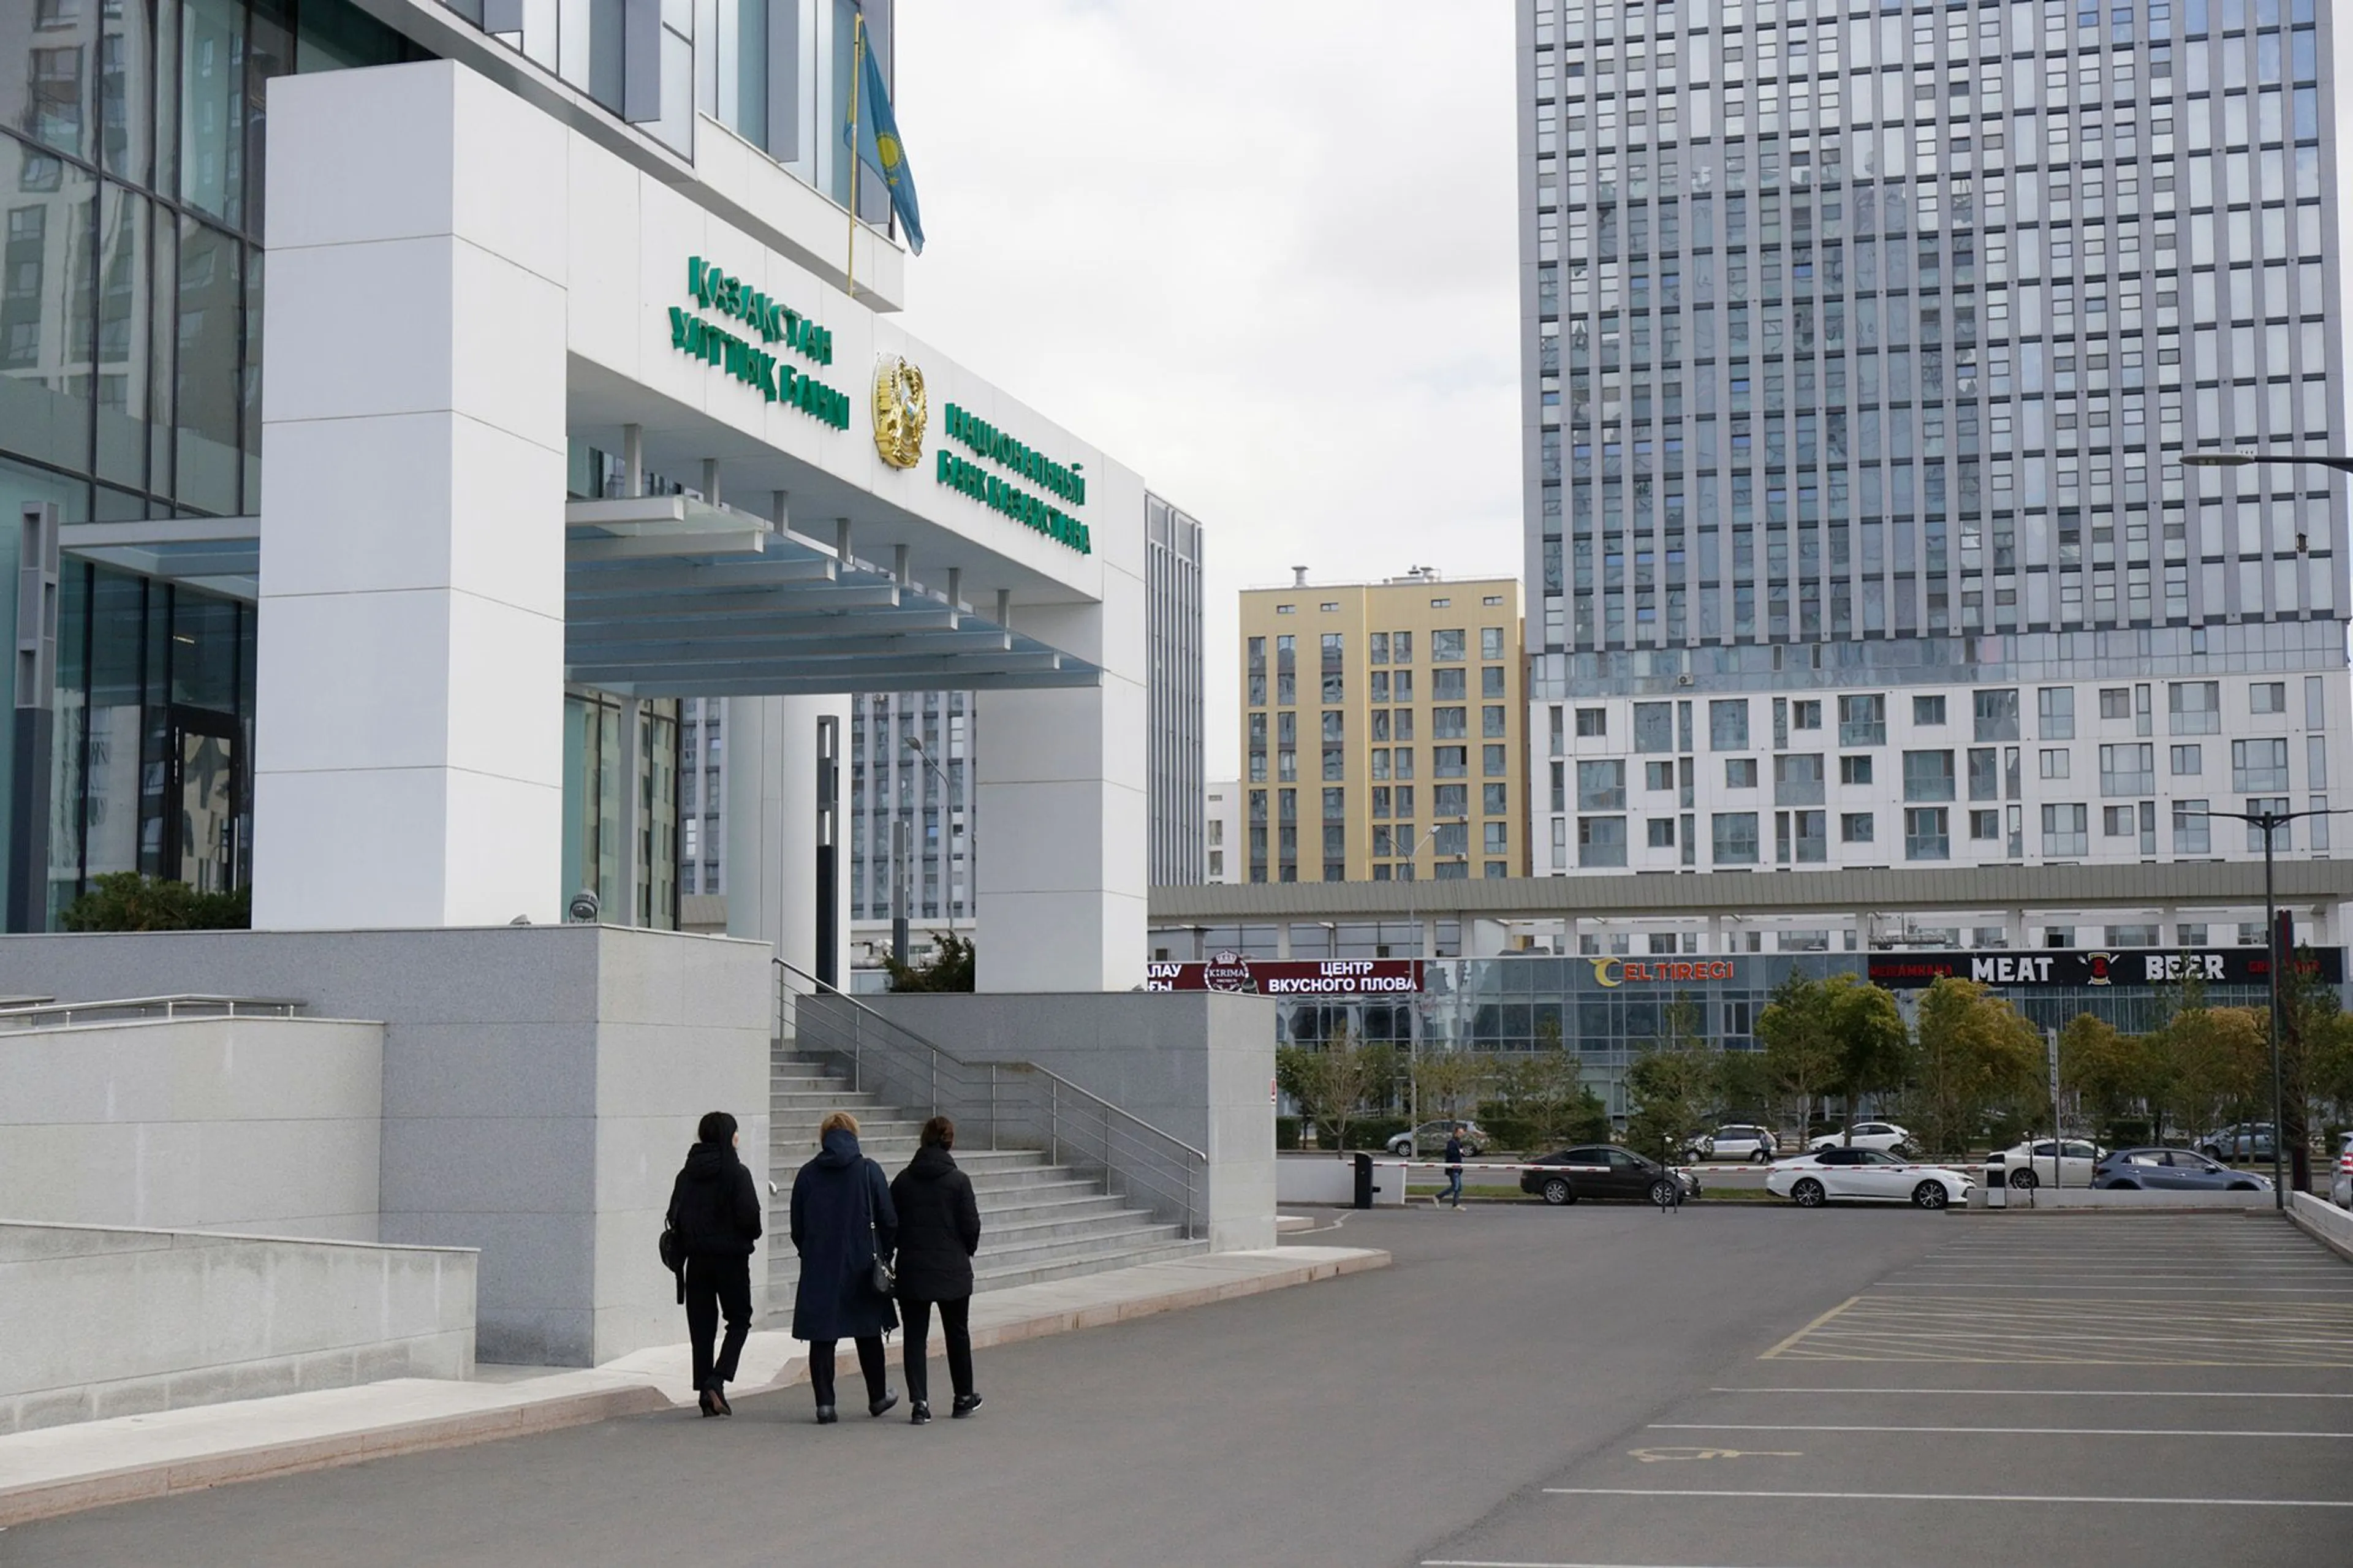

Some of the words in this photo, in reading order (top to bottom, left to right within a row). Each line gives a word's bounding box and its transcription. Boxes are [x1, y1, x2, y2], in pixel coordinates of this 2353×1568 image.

[945, 403, 1085, 506] НАЦИОНАЛЬНЫЙ
[937, 450, 987, 501] БАНК
[987, 476, 1091, 554] КАЗАХСТАНА
[1320, 962, 1374, 977] ЦЕНТР
[1624, 962, 1653, 980] EL
[1971, 957, 2054, 982] MEAT
[2145, 955, 2226, 980] BEER
[1268, 979, 1355, 993] ВКУСНОГО
[1360, 977, 1417, 991] ПЛОВА
